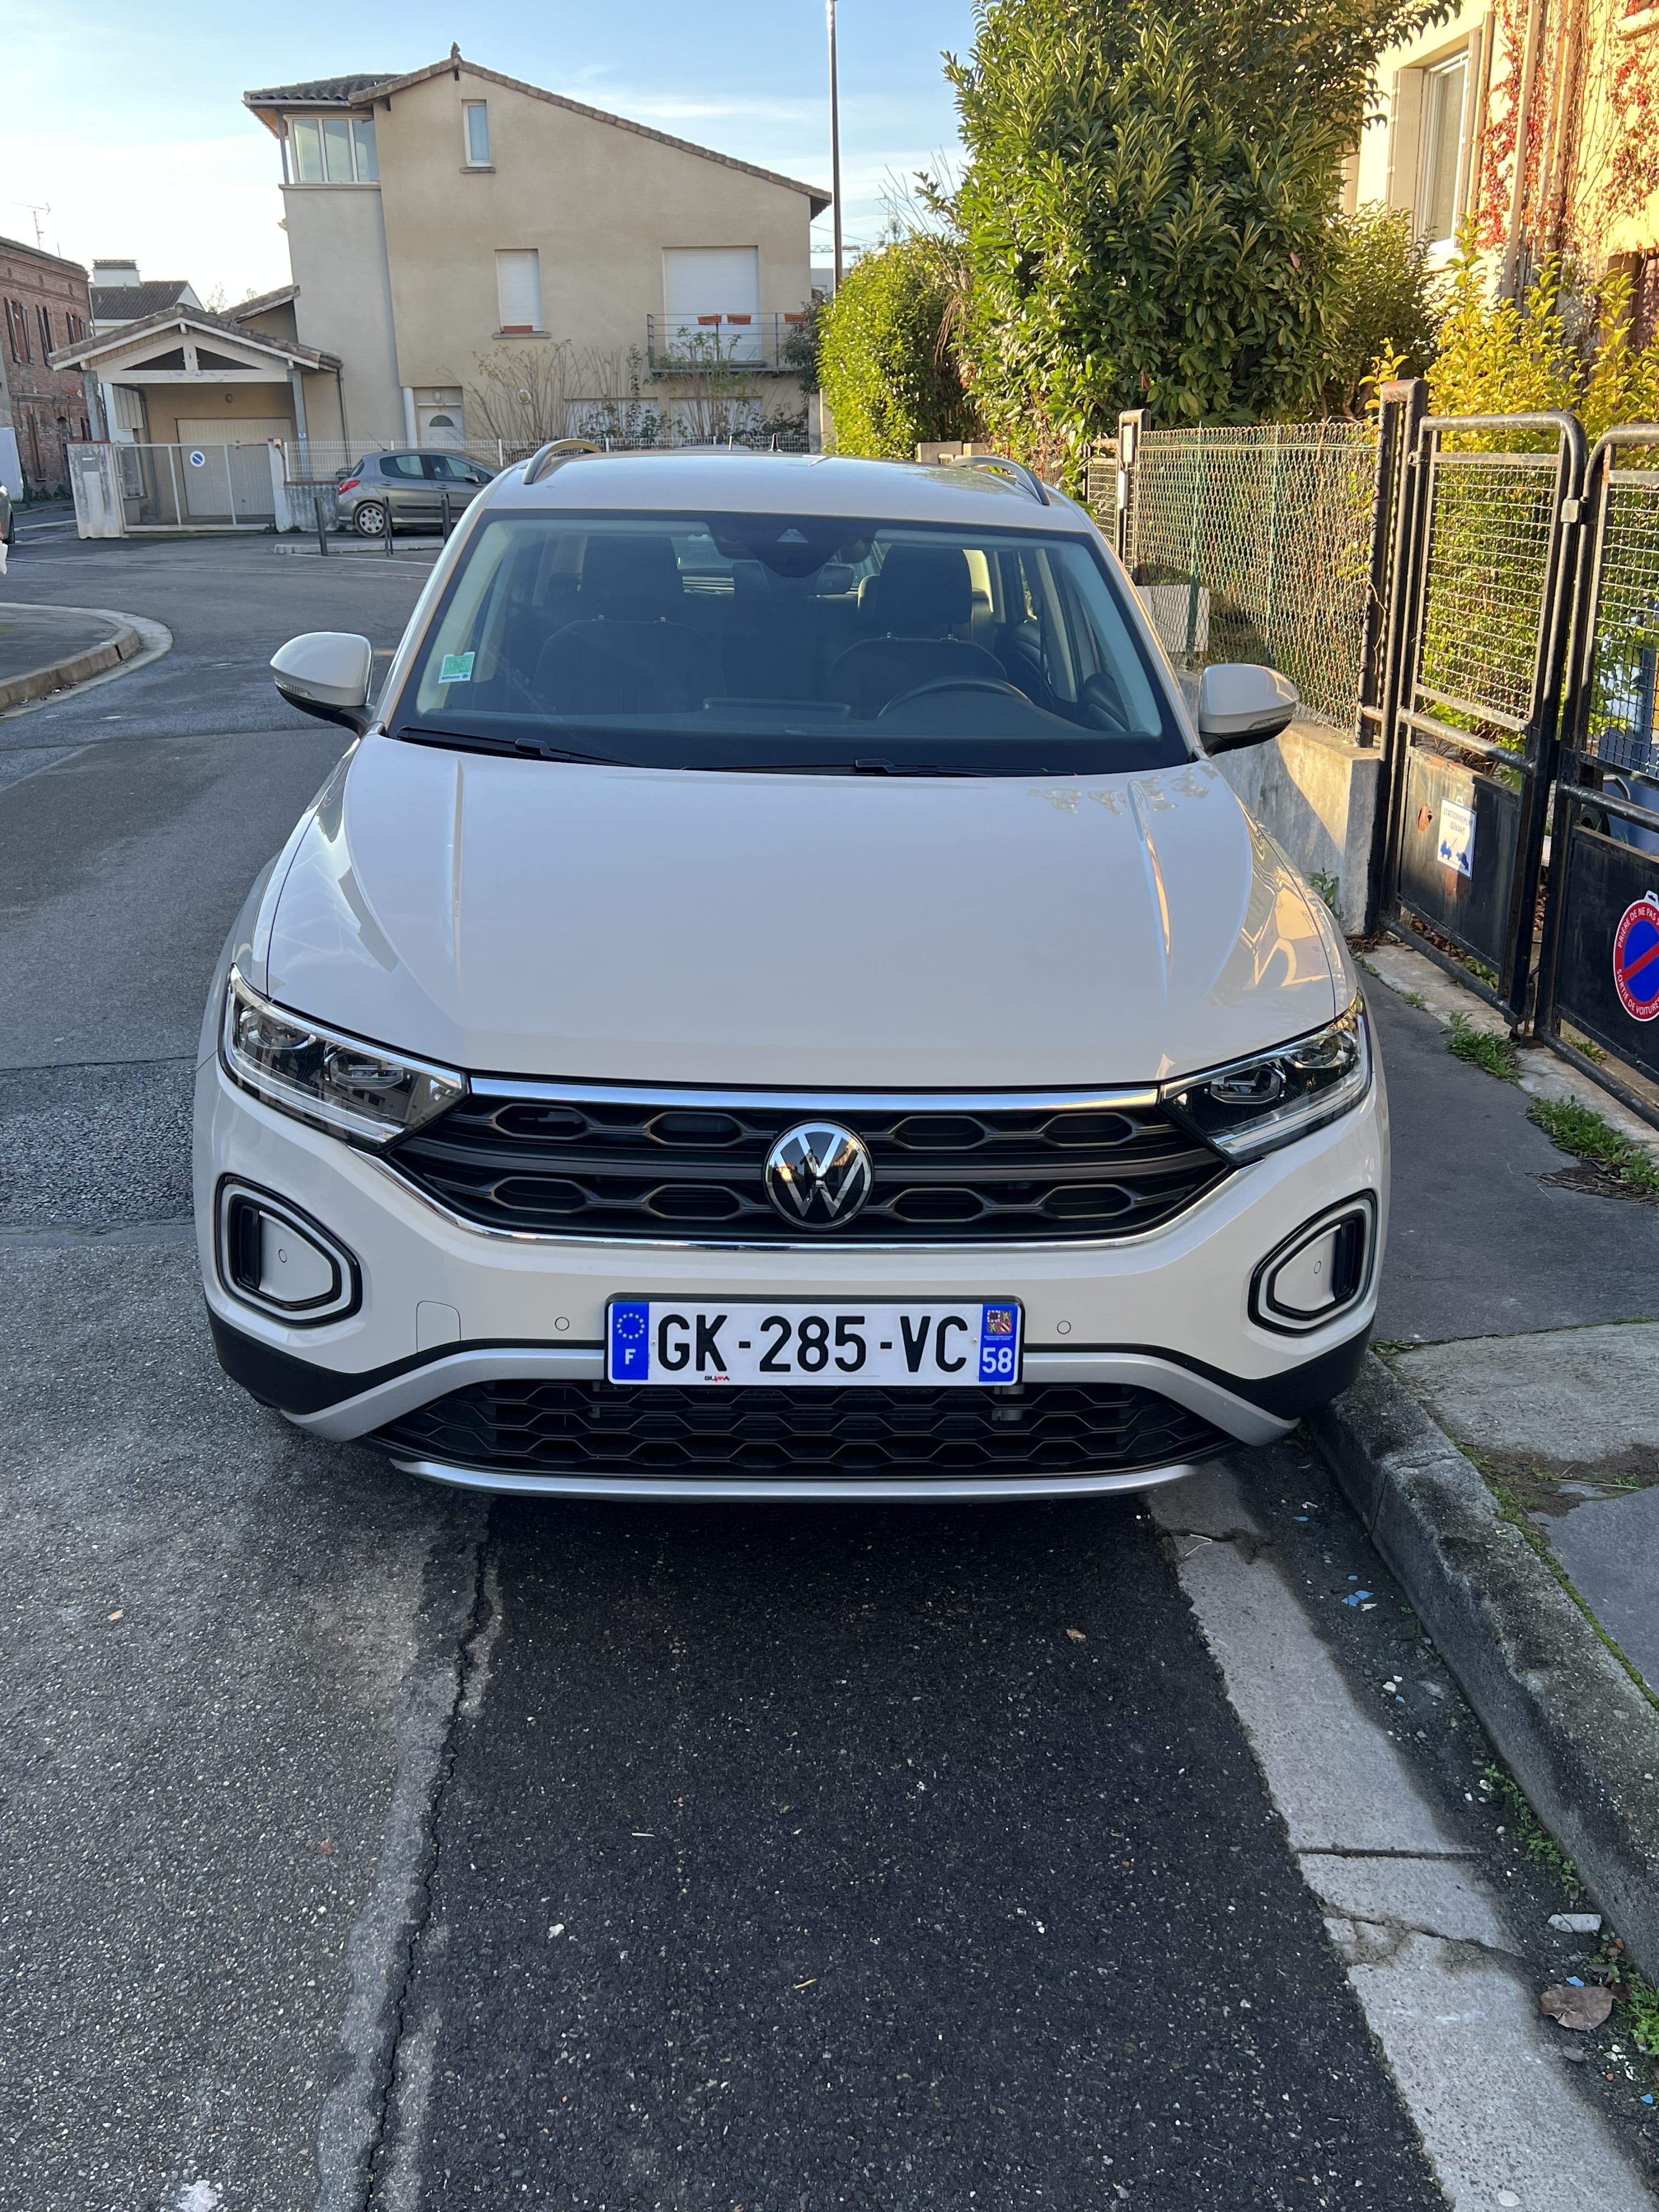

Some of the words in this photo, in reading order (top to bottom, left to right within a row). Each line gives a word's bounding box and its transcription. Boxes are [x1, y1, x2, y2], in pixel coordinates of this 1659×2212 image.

[1630, 909, 1637, 921] DE
[1638, 907, 1646, 916] NE
[1646, 907, 1656, 921] PAS
[1617, 969, 1629, 1001] SORTIE
[1628, 999, 1635, 1011] DE
[658, 1313, 968, 1373] GK-285-VC
[625, 1348, 636, 1365] F
[982, 1347, 1012, 1373] 58
